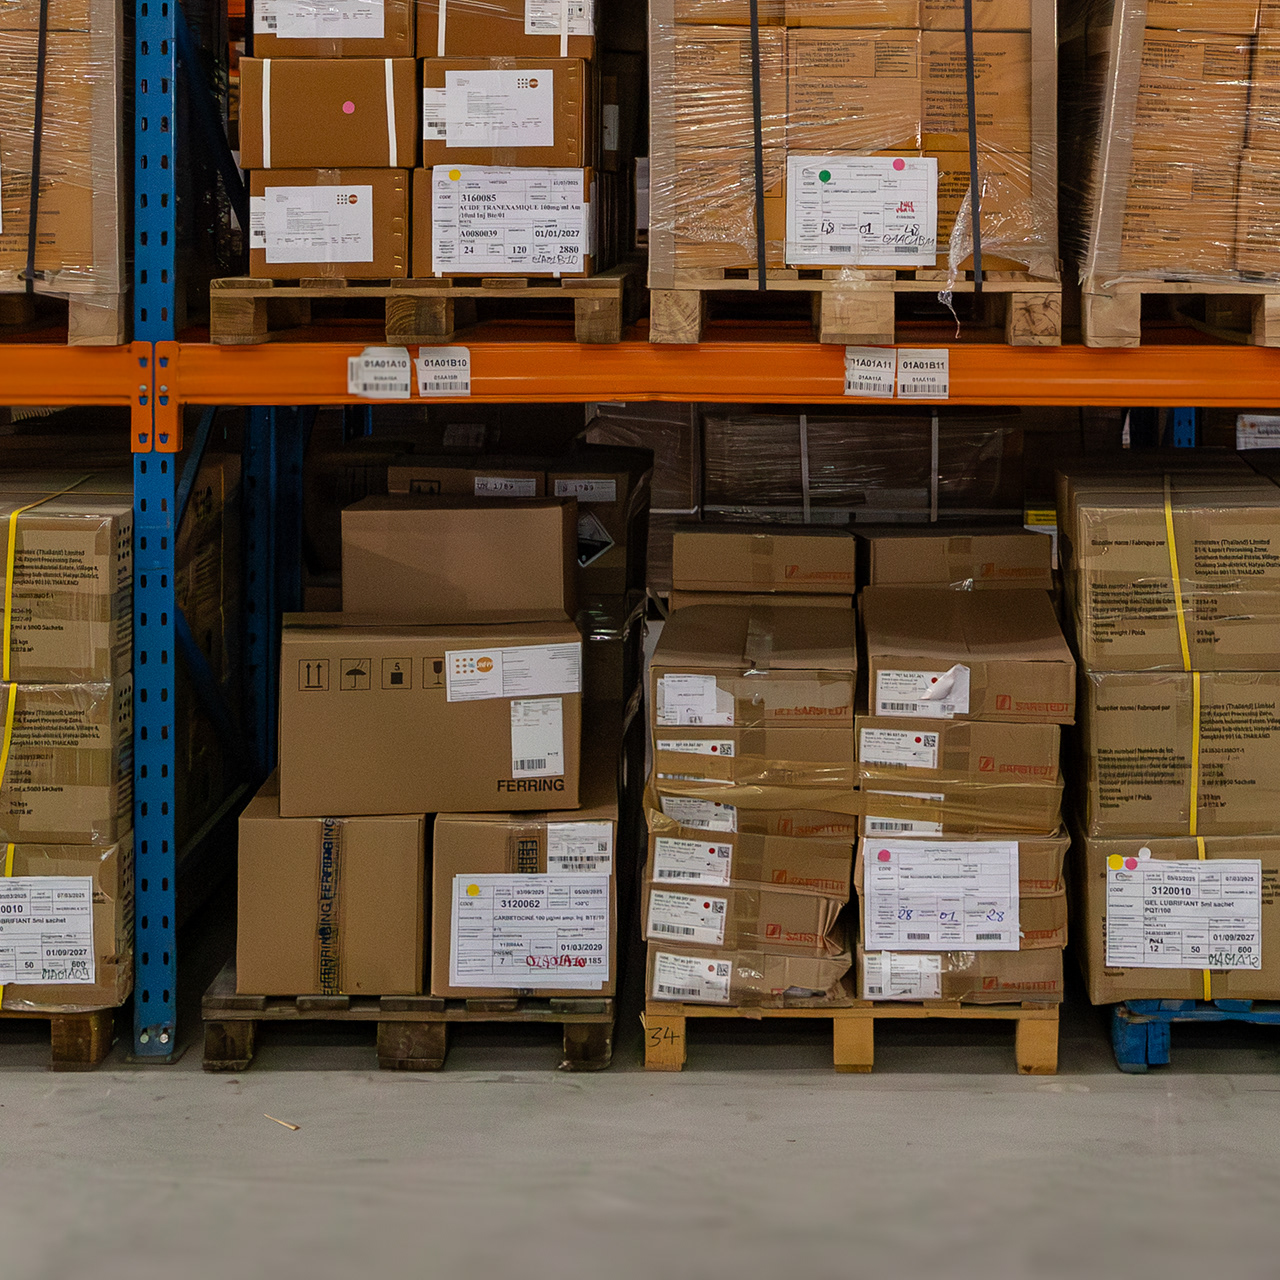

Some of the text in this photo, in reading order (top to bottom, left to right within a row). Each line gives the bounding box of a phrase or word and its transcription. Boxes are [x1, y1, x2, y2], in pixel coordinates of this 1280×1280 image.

[461, 193, 496, 202] 3160085
[535, 228, 580, 238] 01/01/2027
[820, 222, 835, 234] 48
[904, 223, 920, 237] 48
[460, 229, 498, 238] A0080039
[559, 245, 579, 254] 2880
[364, 359, 406, 368] 01A01A10
[424, 359, 467, 367] 01A01B10
[902, 361, 945, 369] 01A01B11
[394, 662, 400, 671] 5
[497, 779, 564, 793] FERRING
[1152, 886, 1191, 896] 3120010
[501, 898, 540, 908] 3120062
[1145, 900, 1159, 908] GEL
[1160, 900, 1199, 908] LUBRIFIANT
[1214, 900, 1235, 909] sachet
[898, 909, 912, 920] 28
[986, 910, 1004, 922] 28
[46, 917, 66, 925] sachet
[1213, 933, 1255, 943] 01/09/2027
[560, 942, 603, 952] 01/03/2029
[46, 948, 87, 958] 01/09/2027
[648, 1027, 680, 1048] 34
